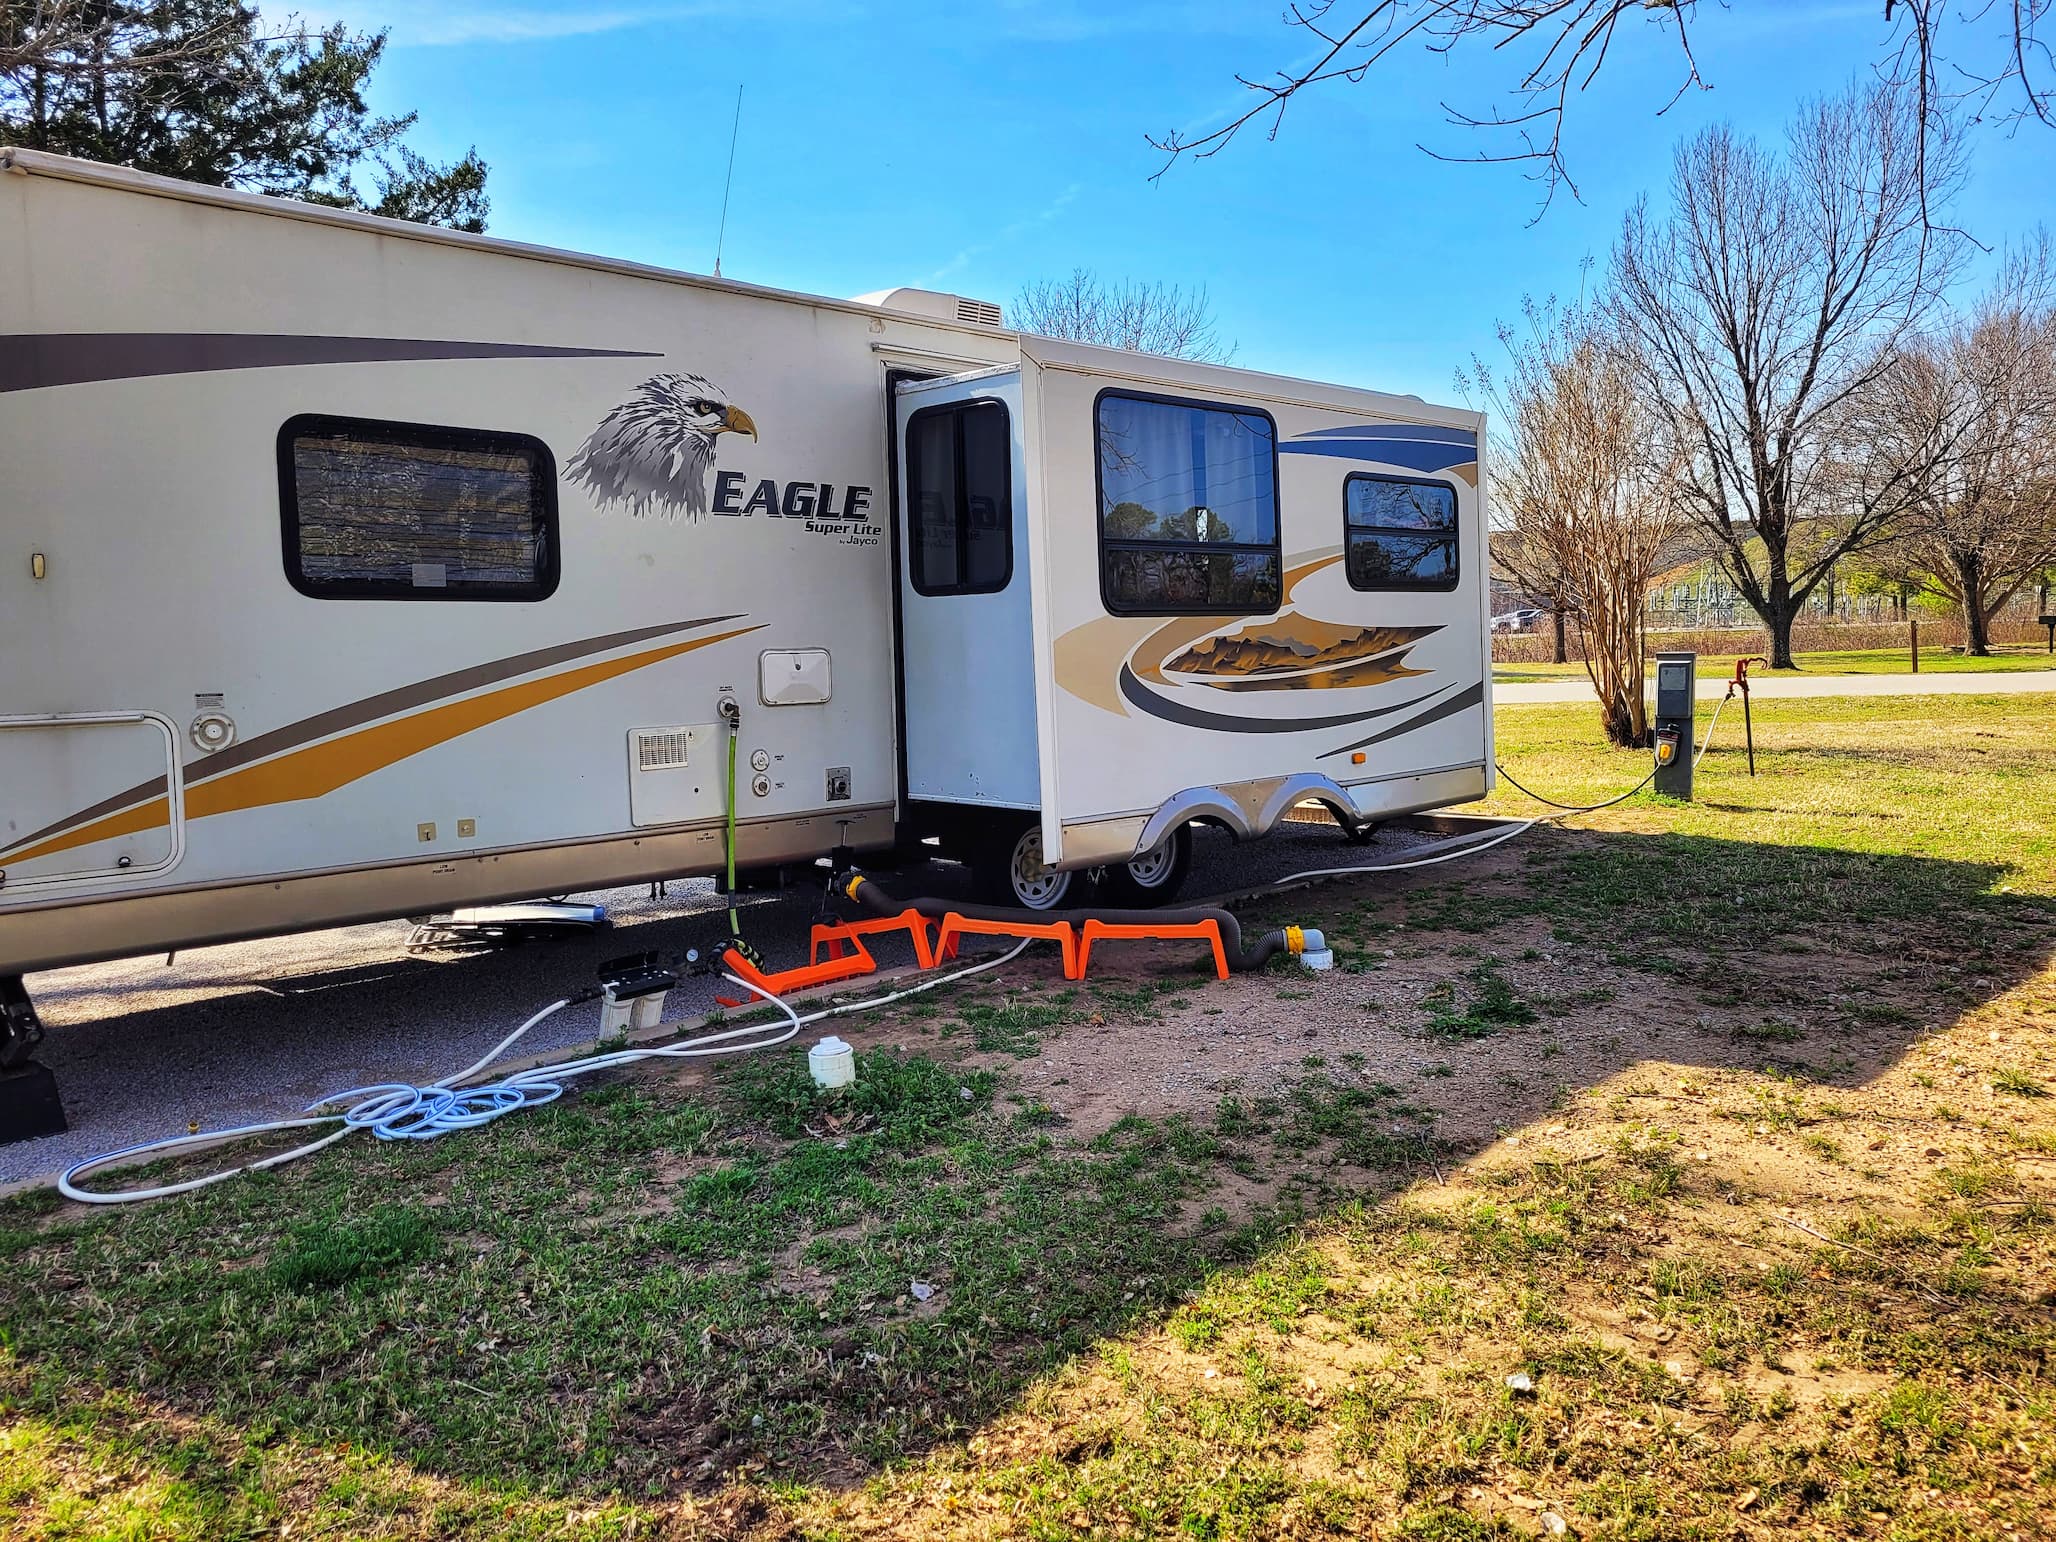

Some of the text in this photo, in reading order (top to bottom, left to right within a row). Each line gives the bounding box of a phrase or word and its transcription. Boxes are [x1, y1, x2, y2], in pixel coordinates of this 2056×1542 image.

[711, 470, 873, 522] EAGLE
[804, 520, 882, 536] Super Lite
[846, 535, 879, 547] Jayco
